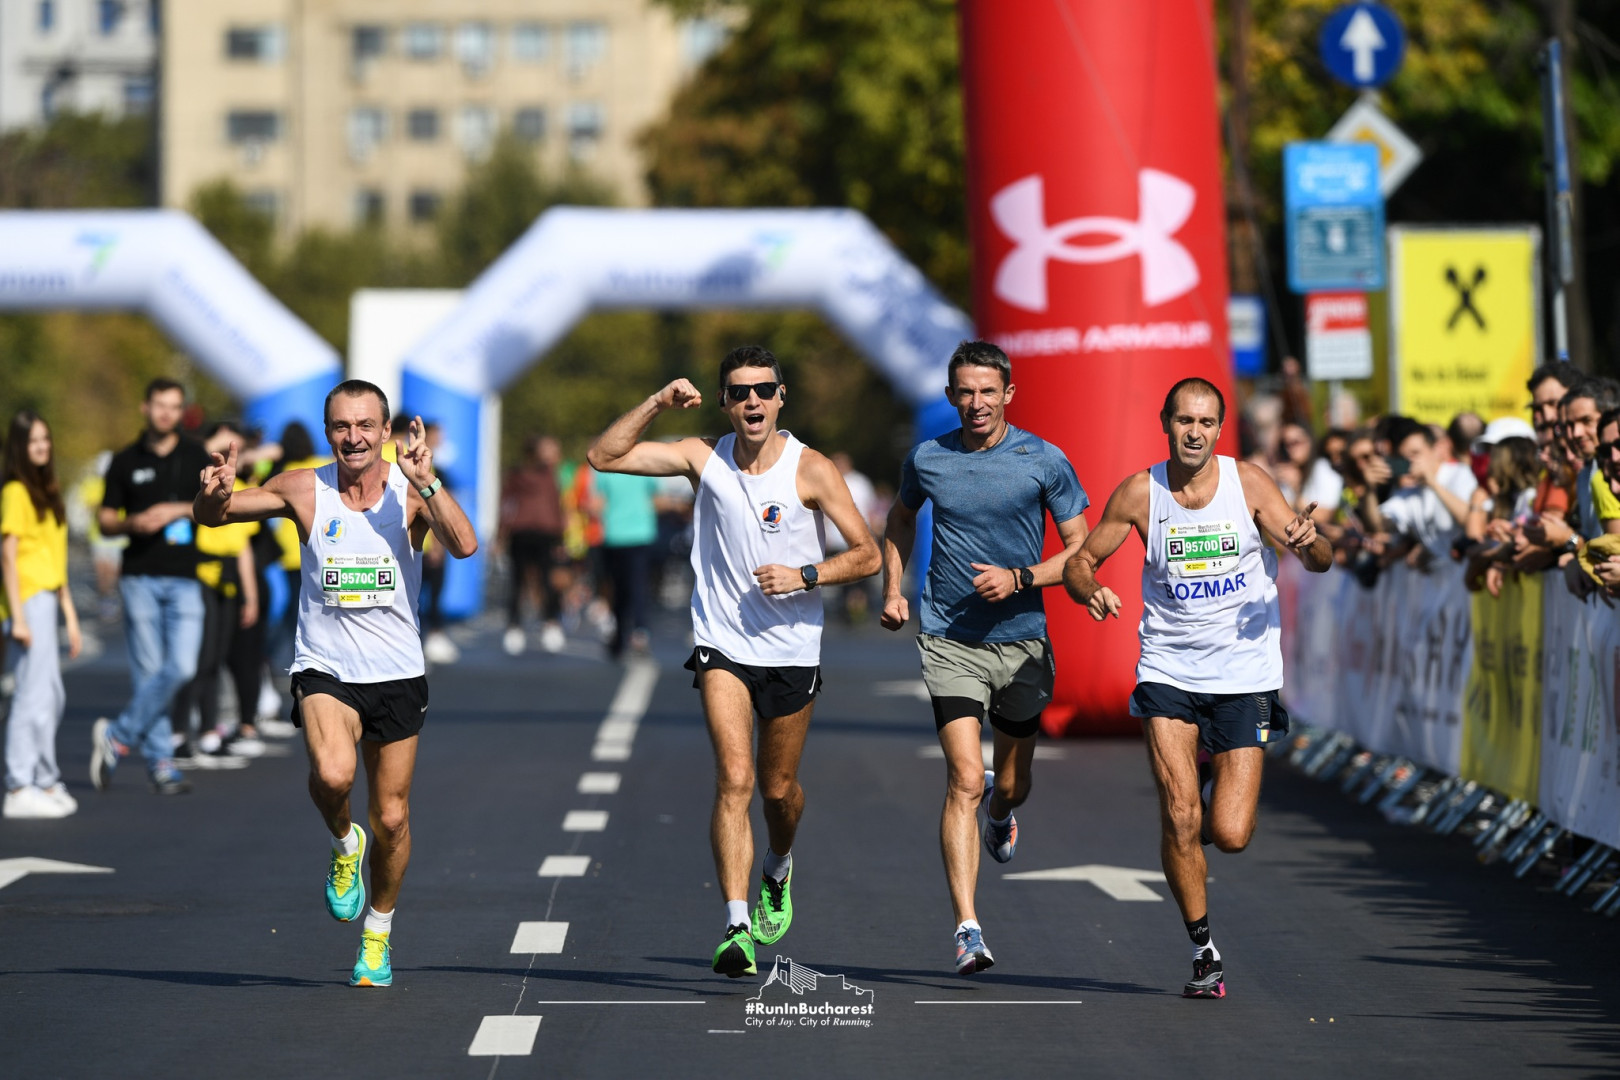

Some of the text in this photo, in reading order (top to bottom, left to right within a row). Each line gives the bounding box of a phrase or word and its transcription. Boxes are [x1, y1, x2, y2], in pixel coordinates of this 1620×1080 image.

[1082, 320, 1211, 352] ARMOUR
[1185, 540, 1218, 553] 9570D
[341, 572, 375, 584] 9570C
[1163, 572, 1246, 600] BOZMAR
